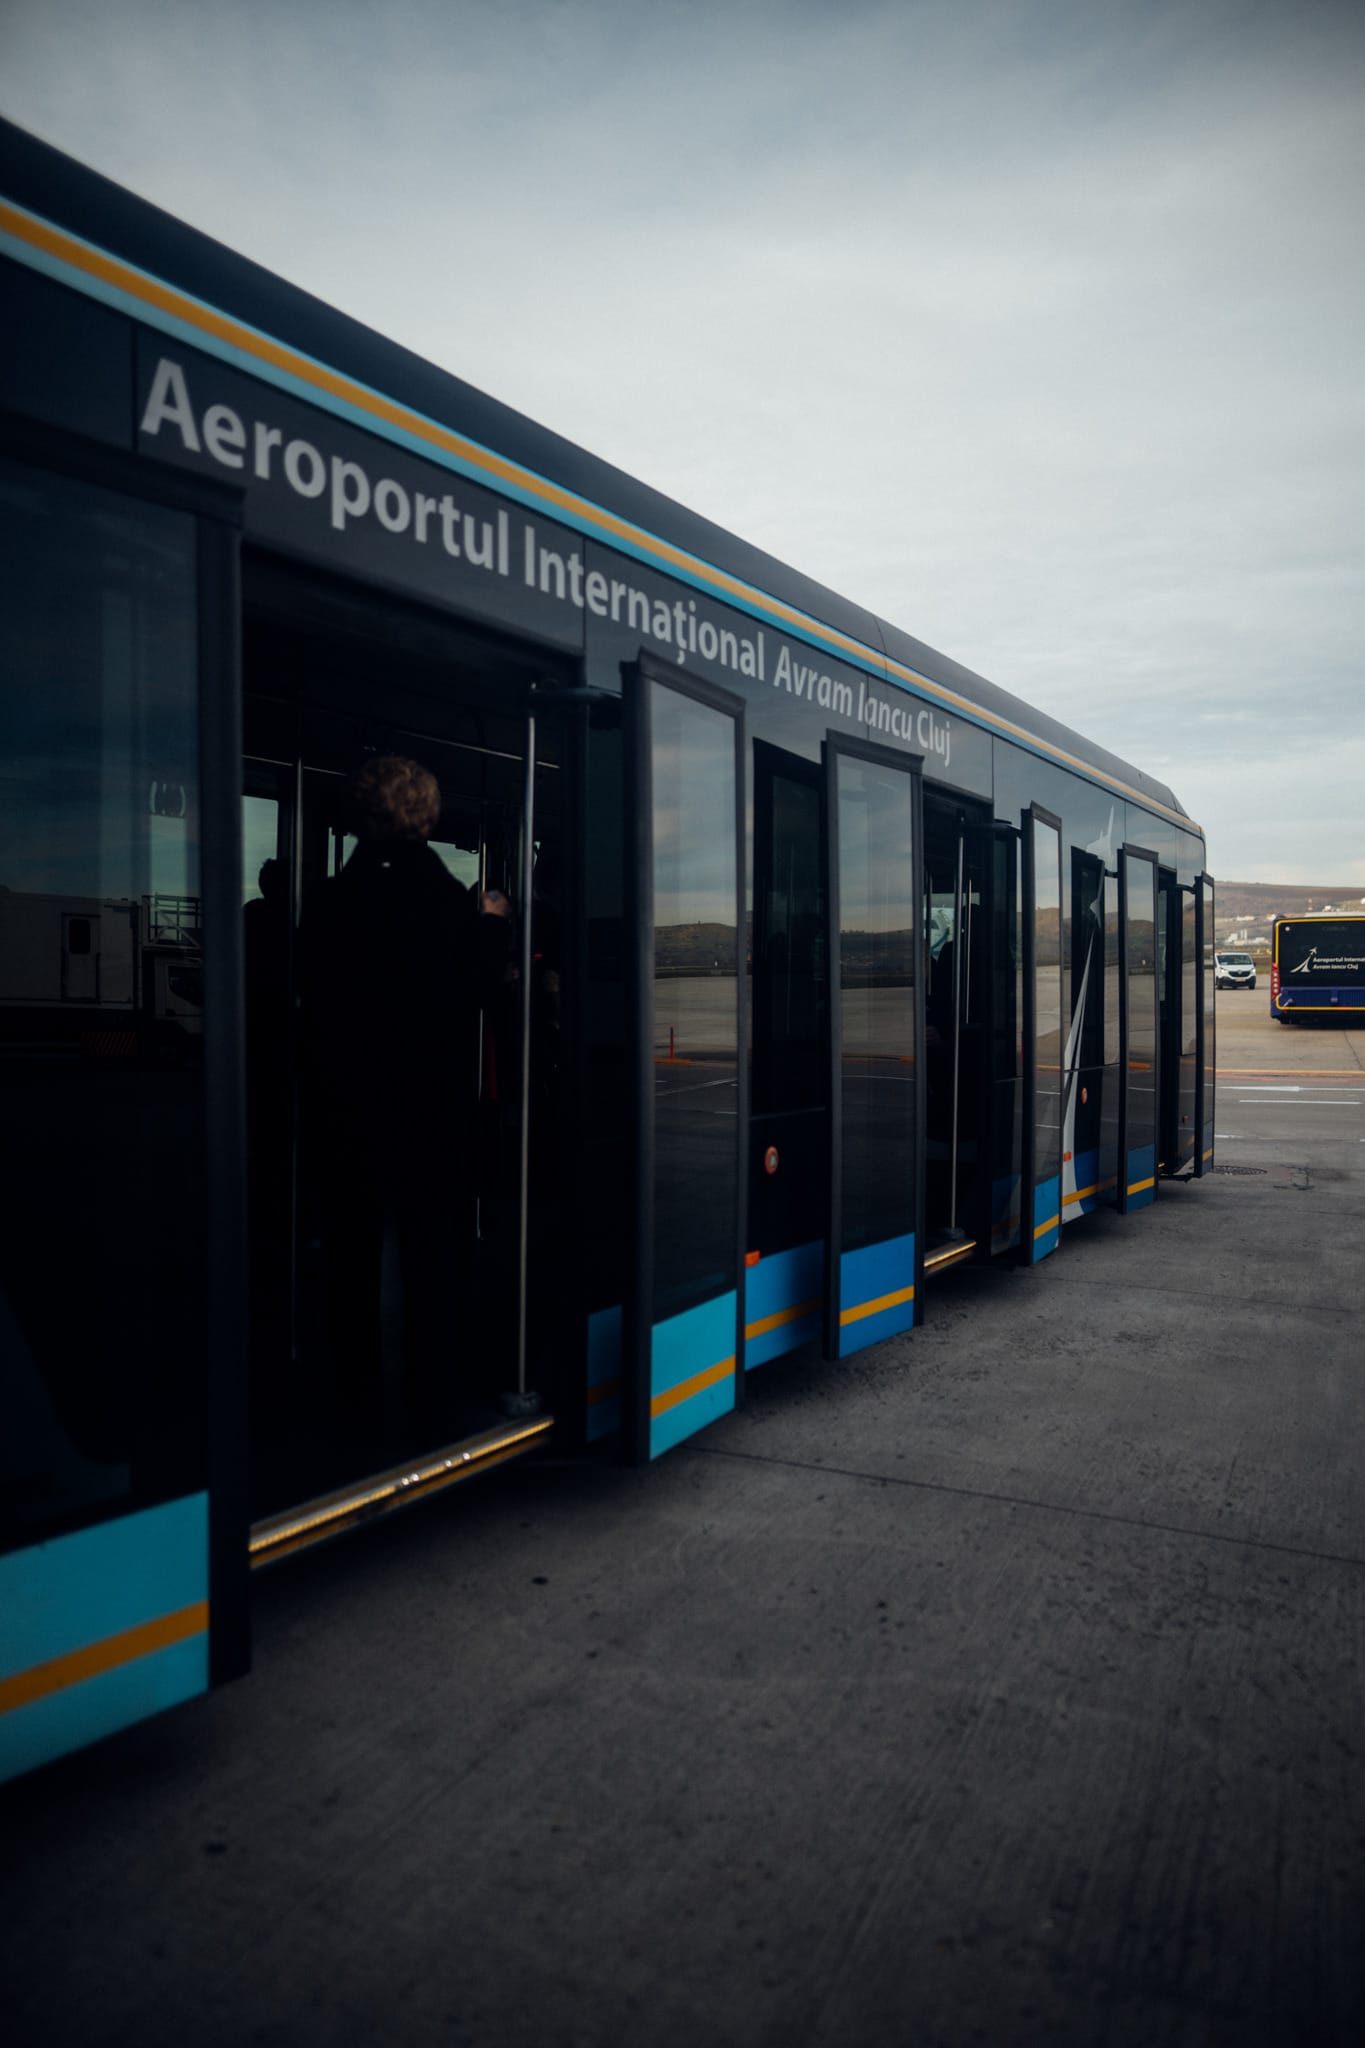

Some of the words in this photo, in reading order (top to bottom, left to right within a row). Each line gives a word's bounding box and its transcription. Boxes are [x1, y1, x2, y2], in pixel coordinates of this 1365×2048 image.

[140, 358, 510, 577] Aeroportul
[773, 645, 853, 722] Avram
[858, 682, 912, 742] Iancu
[916, 709, 951, 768] Cluj
